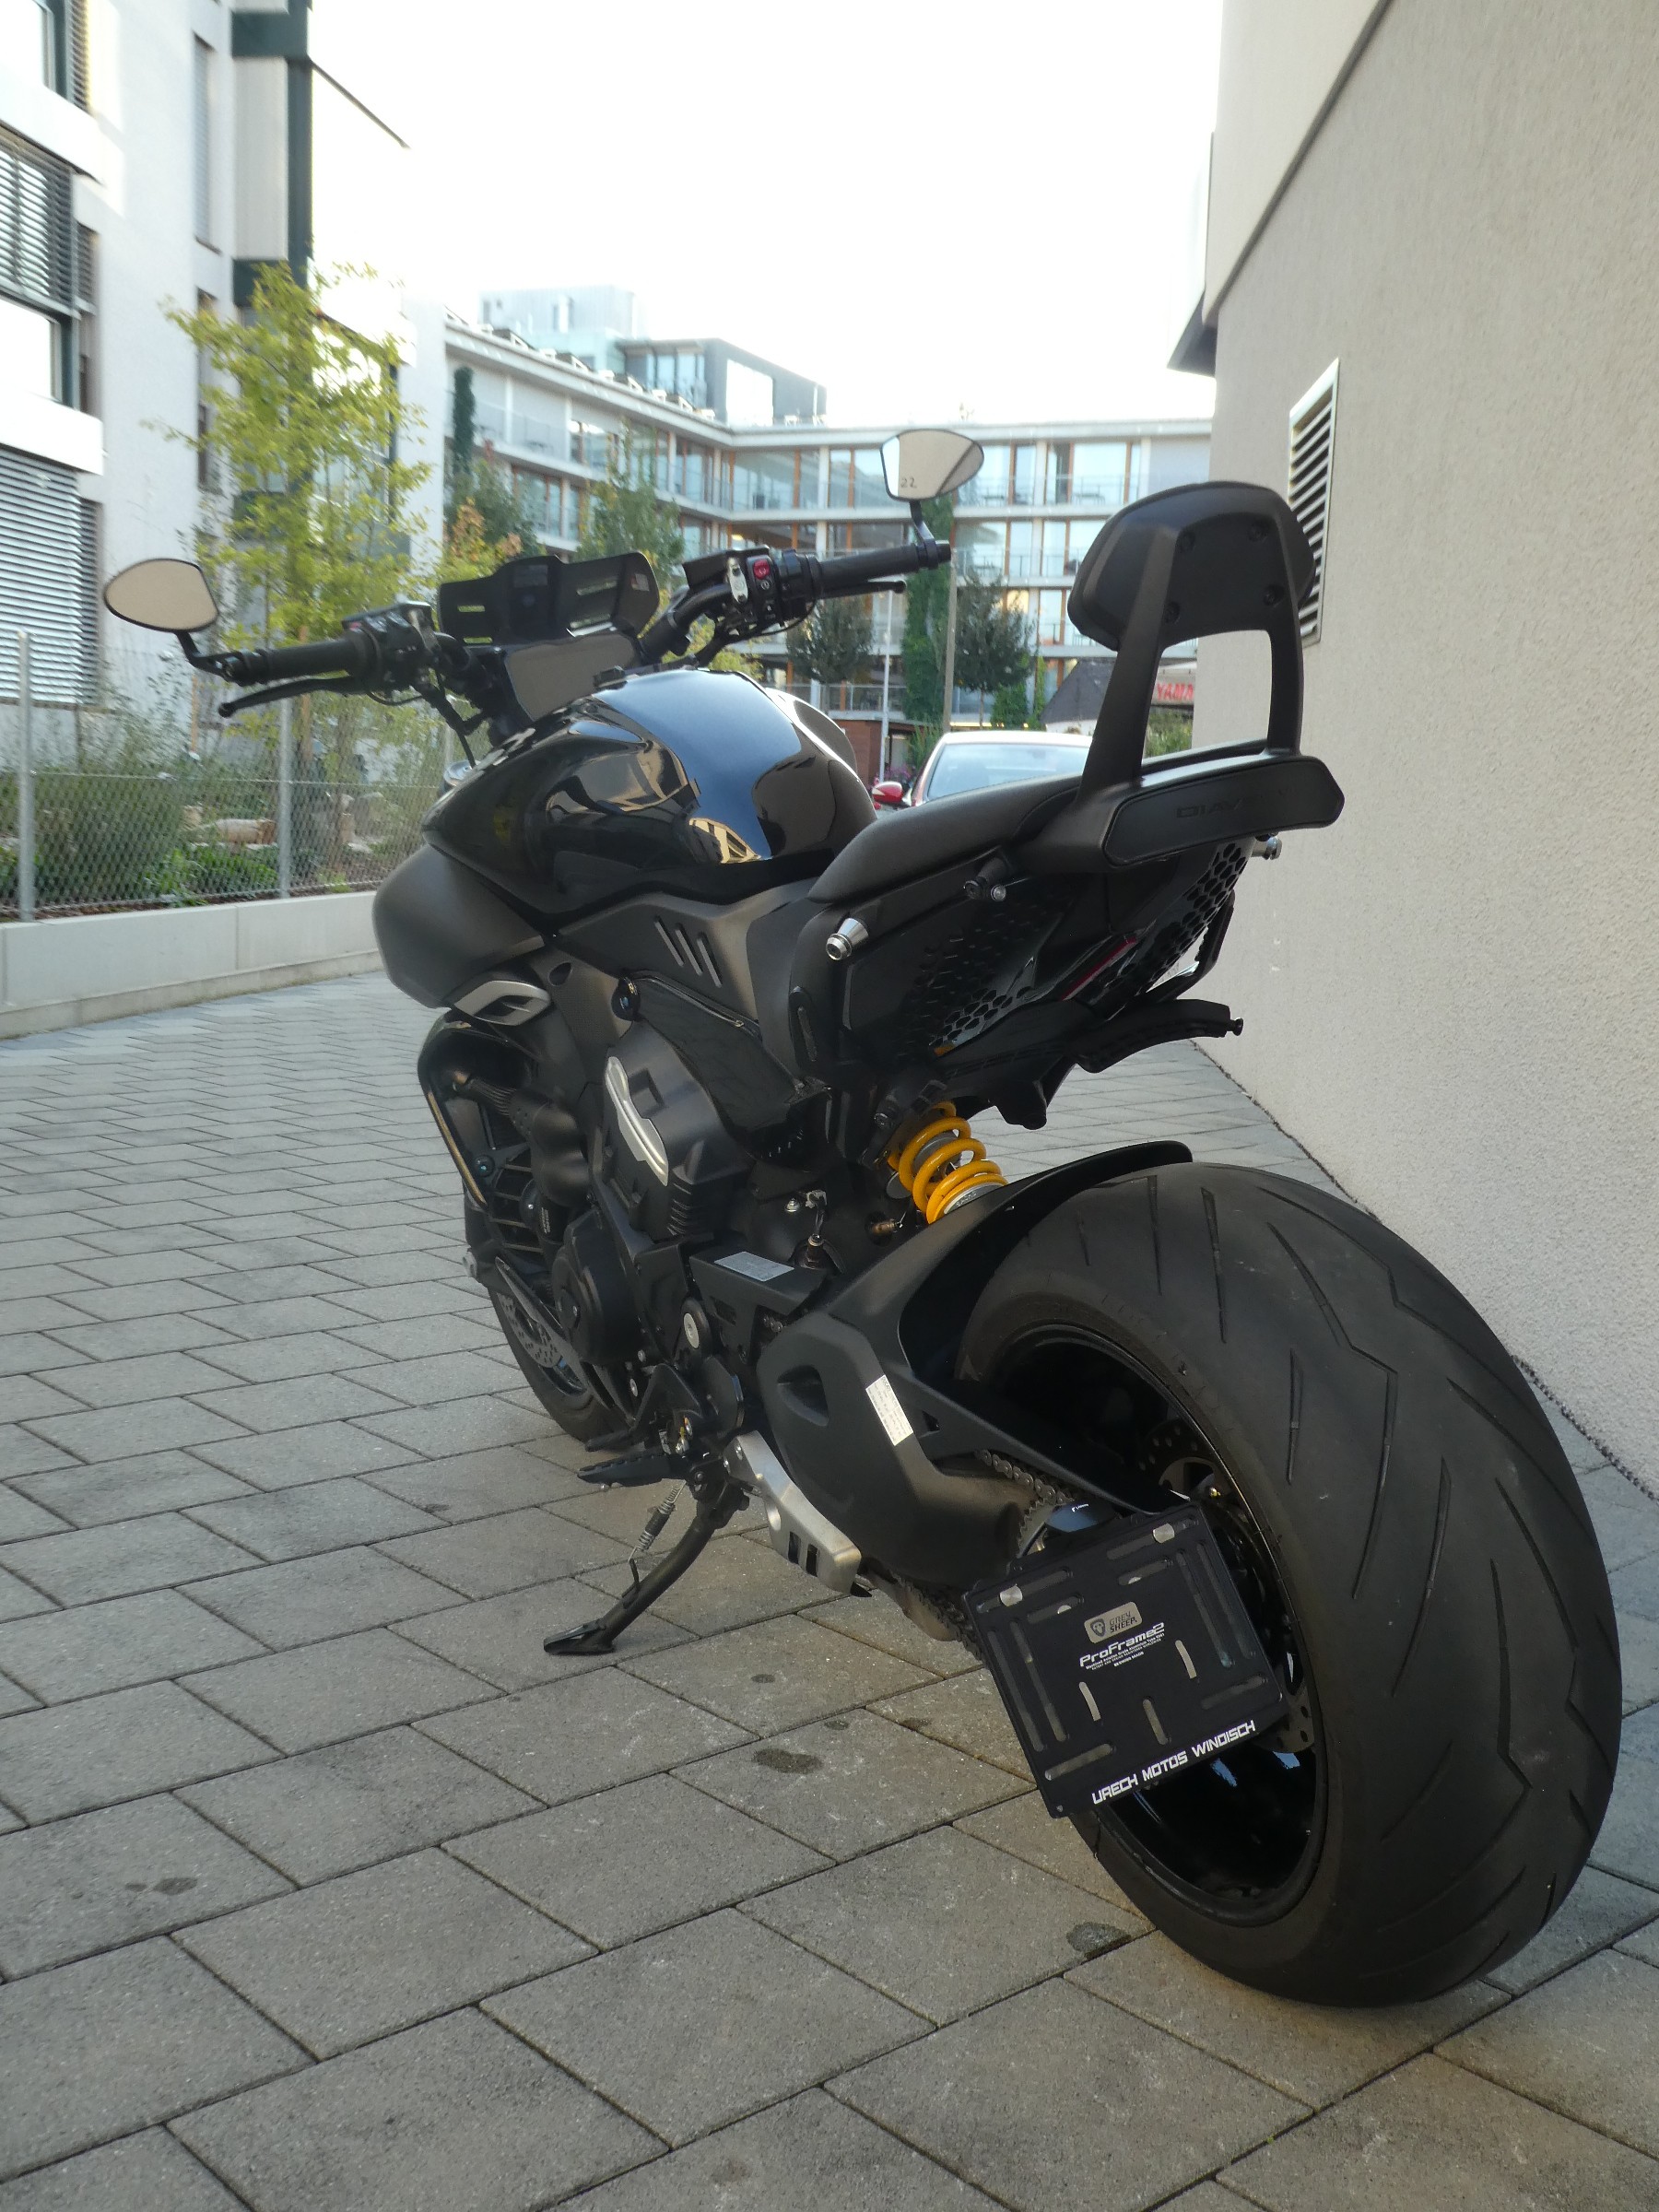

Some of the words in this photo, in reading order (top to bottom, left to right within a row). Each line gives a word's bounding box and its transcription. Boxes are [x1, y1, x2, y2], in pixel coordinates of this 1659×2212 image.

[1109, 1611, 1131, 1626] GREY
[1079, 1622, 1166, 1667] ProFrame2
[1091, 1773, 1139, 1805] URECH
[1142, 1750, 1188, 1782] MOTOS
[1192, 1719, 1256, 1758] WINDISCH
